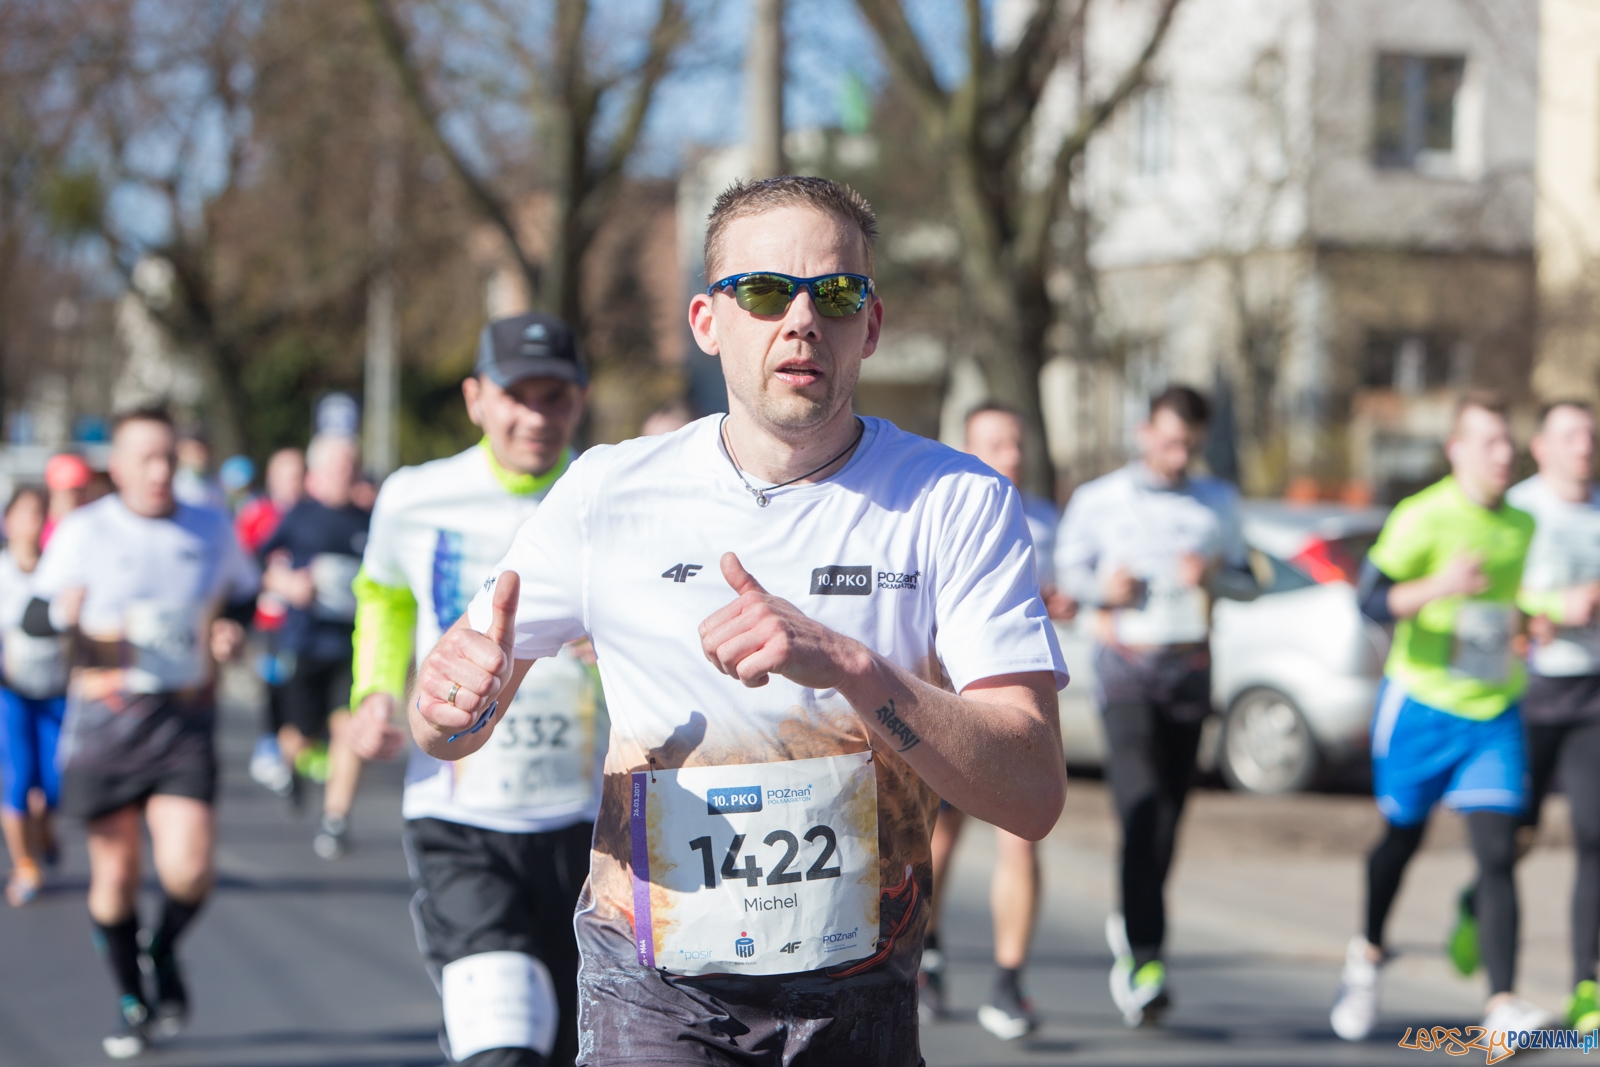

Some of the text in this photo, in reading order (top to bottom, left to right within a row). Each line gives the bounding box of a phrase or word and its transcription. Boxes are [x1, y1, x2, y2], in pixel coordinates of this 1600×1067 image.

[661, 563, 703, 583] 4F
[817, 573, 867, 587] 10. PKO
[712, 793, 758, 807] 10. PKO
[688, 825, 841, 890] 1422
[744, 893, 798, 913] Michel
[639, 939, 647, 954] M44
[780, 940, 802, 954] 4F
